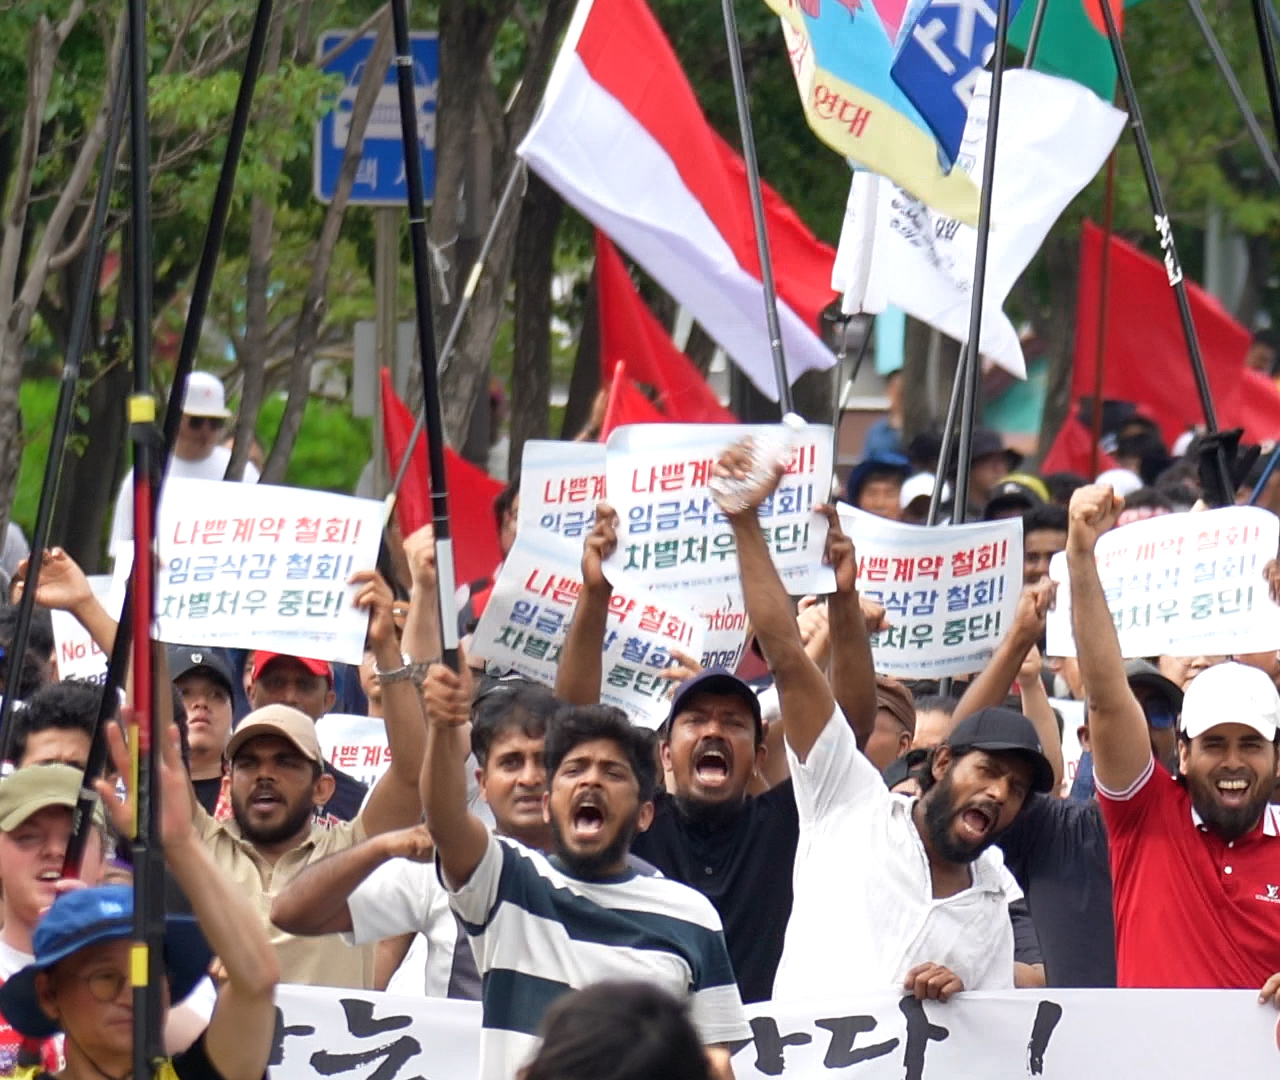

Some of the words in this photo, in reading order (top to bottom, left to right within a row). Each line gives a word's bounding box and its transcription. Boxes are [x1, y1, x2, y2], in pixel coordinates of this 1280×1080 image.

[543, 475, 607, 504] 나쁜계
[630, 458, 714, 495] 나쁜계
[173, 516, 286, 546] 나쁜계약
[294, 516, 362, 546] 철회!
[168, 554, 277, 585] 임금삭감
[285, 553, 354, 582] 철회!
[622, 533, 737, 571] 차별처우
[951, 538, 1008, 578] 철회!
[159, 589, 268, 620] 차별처우
[277, 589, 345, 619] 중단!
[946, 574, 1005, 613] 철회!
[1190, 585, 1254, 621] 중단!
[638, 603, 694, 648] 철회!
[942, 610, 1002, 647] 중단!
[61, 639, 86, 663] No
